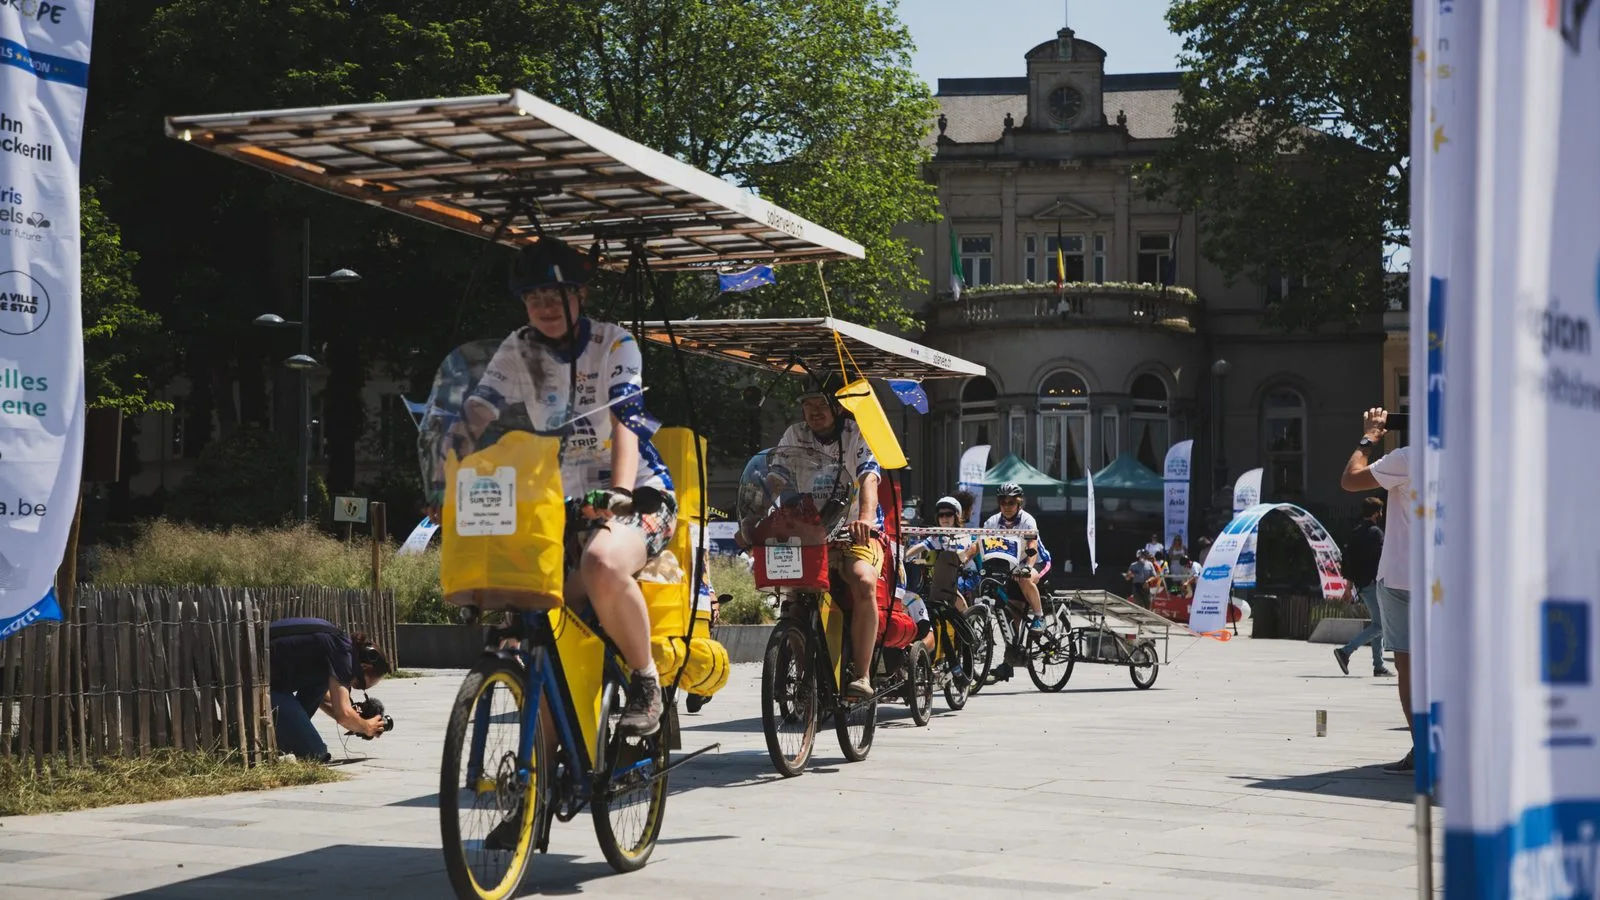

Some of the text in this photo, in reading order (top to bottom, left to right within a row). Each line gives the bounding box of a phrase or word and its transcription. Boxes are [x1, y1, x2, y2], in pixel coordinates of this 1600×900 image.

[0, 135, 52, 162] ckerill
[767, 208, 803, 238] solarvelo.ch
[15, 228, 42, 242] future
[9, 293, 38, 305] VILLE
[10, 303, 38, 314] STAD
[0, 368, 48, 391] lles
[571, 437, 598, 448] TRIP
[486, 496, 502, 504] TRIP
